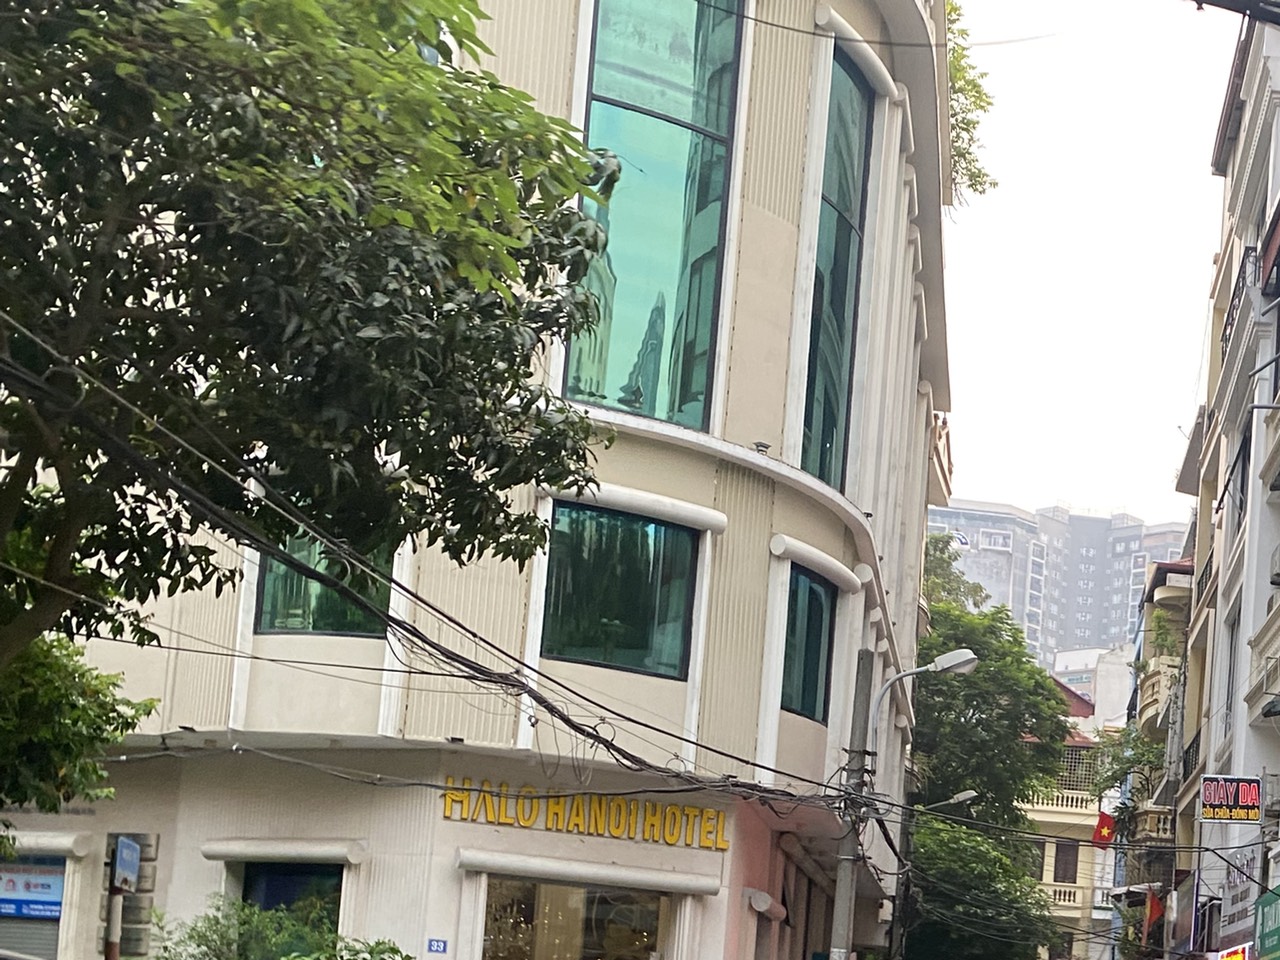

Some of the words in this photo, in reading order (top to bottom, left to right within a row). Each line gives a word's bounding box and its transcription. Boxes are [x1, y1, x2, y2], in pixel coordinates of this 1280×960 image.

[1203, 778, 1237, 805] GIÀY
[1239, 783, 1260, 806] DA
[440, 776, 540, 828] HALO
[546, 789, 638, 839] HANOI
[643, 801, 730, 850] HOTEL
[431, 940, 444, 951] 33
